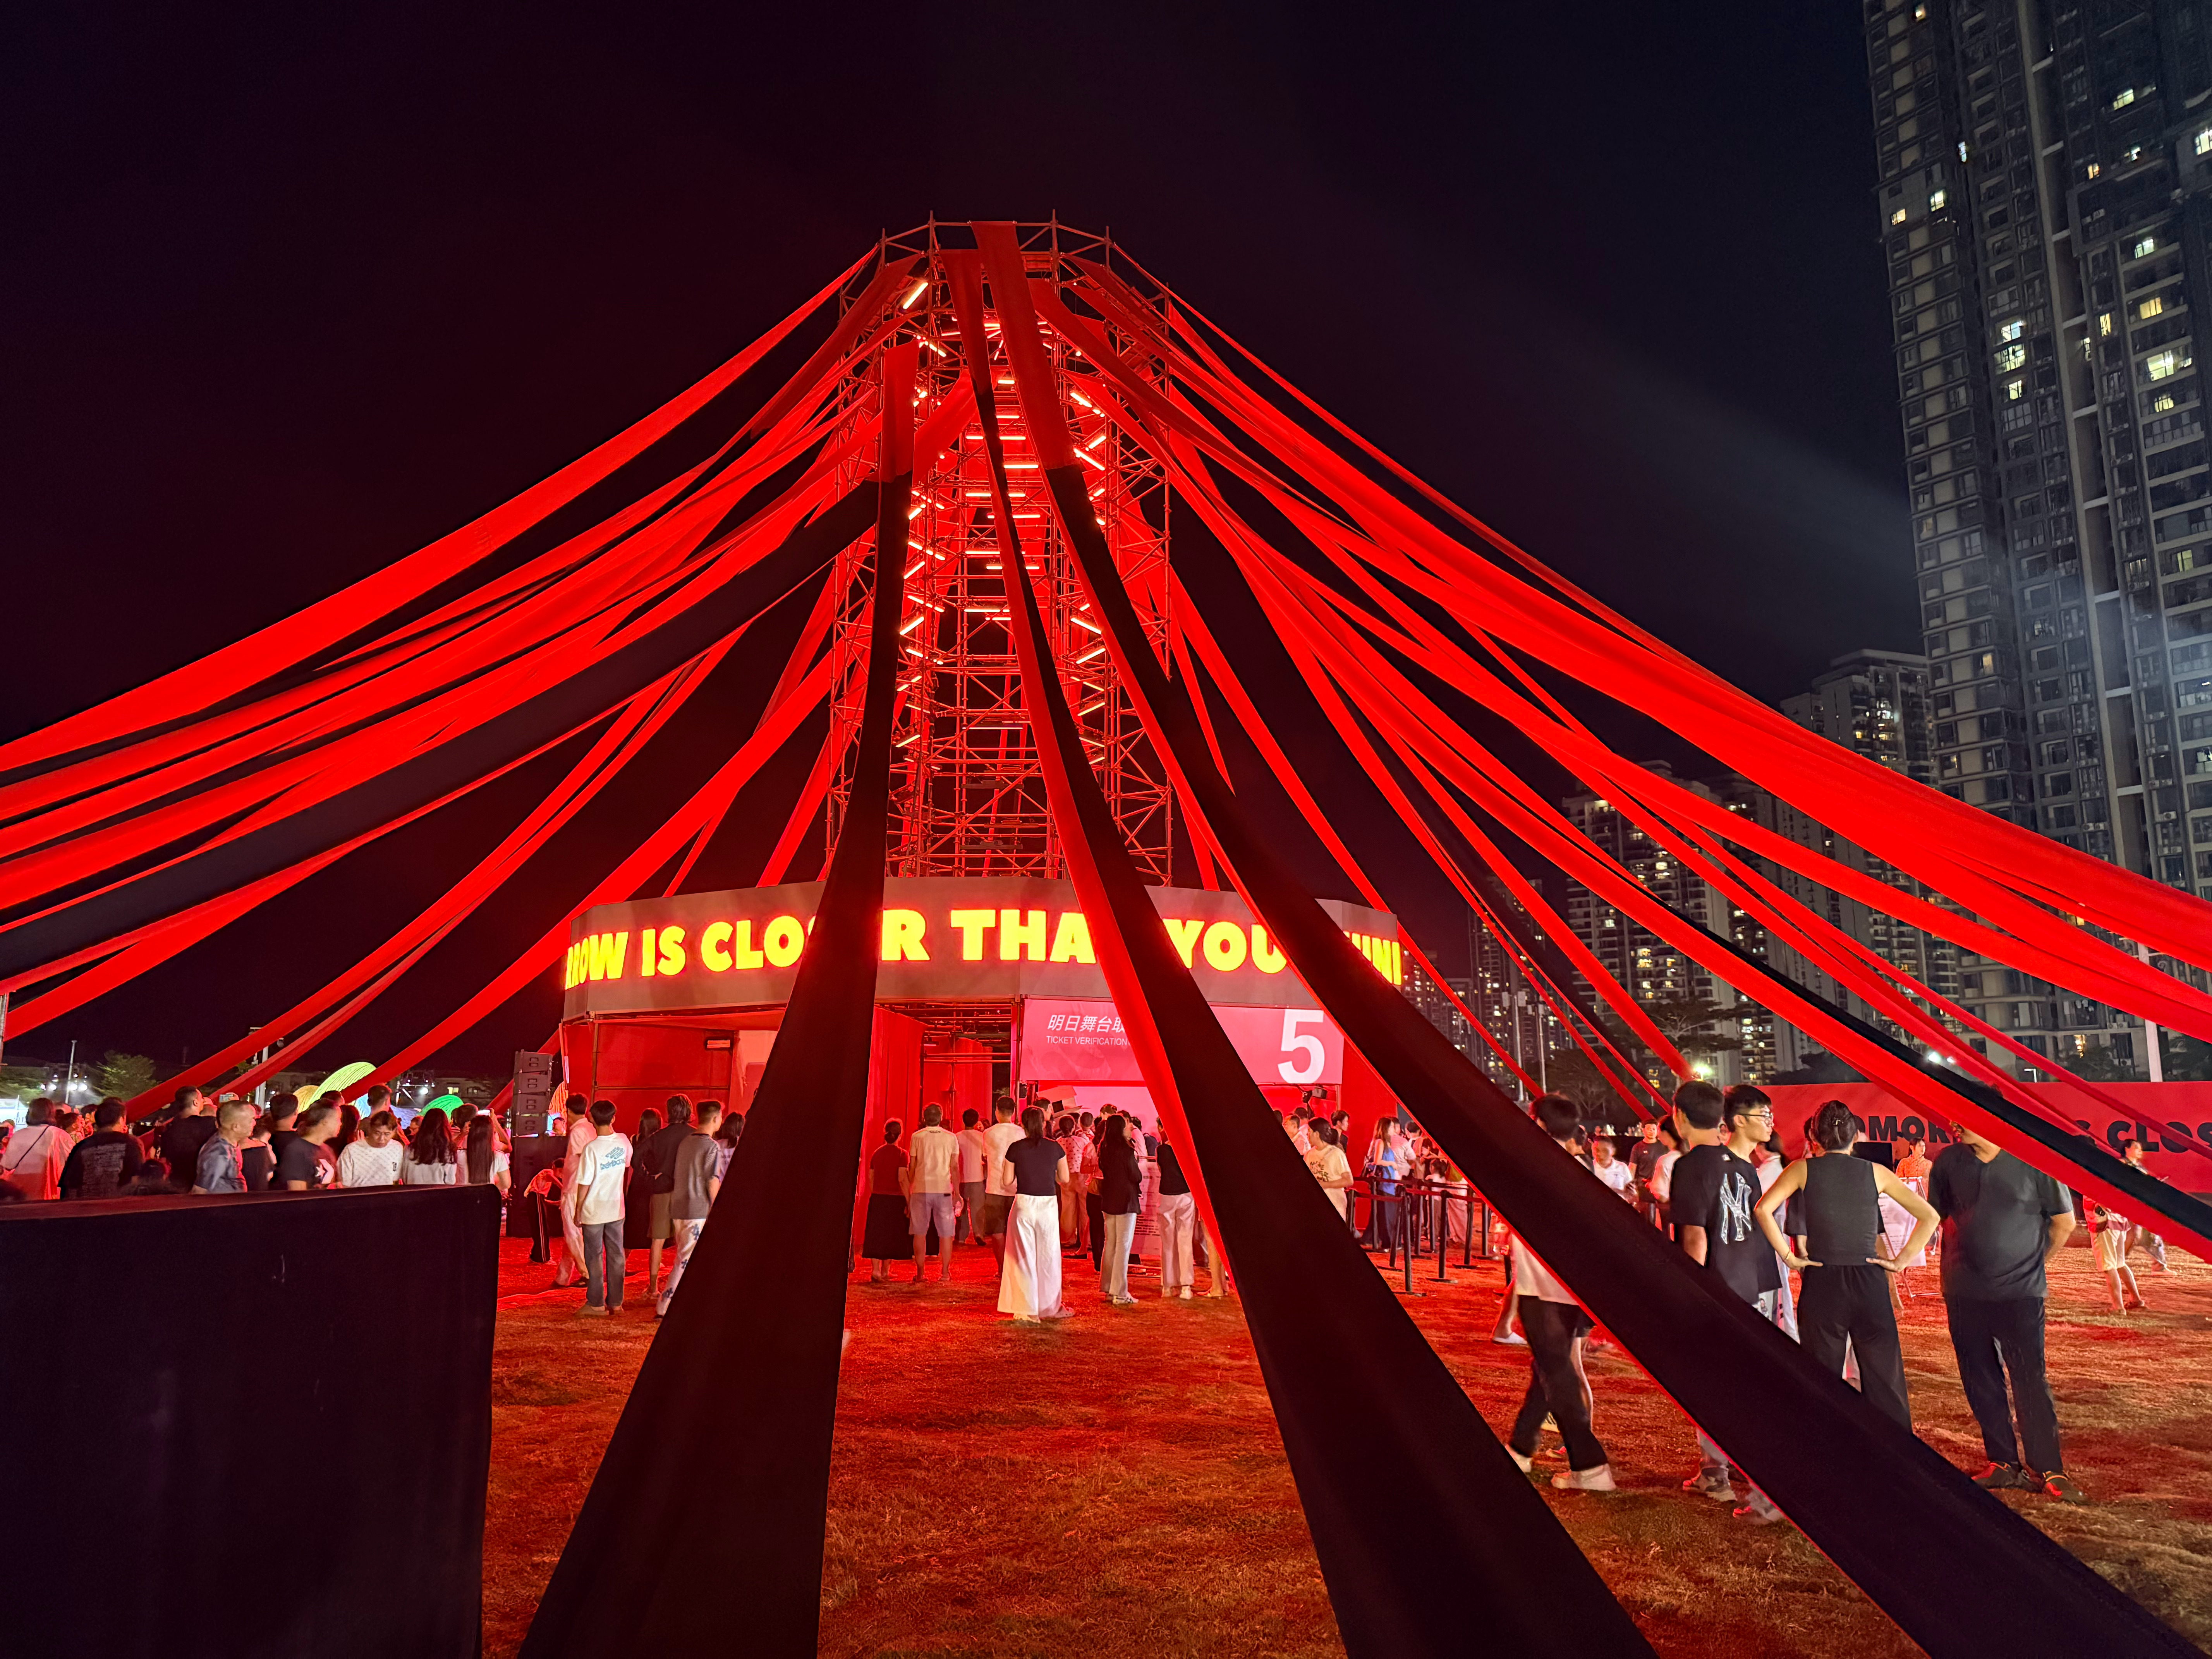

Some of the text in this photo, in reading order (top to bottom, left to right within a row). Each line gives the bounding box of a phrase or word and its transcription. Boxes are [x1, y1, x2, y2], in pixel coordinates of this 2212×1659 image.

[642, 926, 686, 976] IS
[951, 909, 1096, 964] THA
[1163, 919, 1287, 974] YOU
[1046, 1036, 1074, 1044] TICKET
[1075, 1037, 1128, 1046] VERIFICATION
[1277, 1009, 1325, 1084] 5
